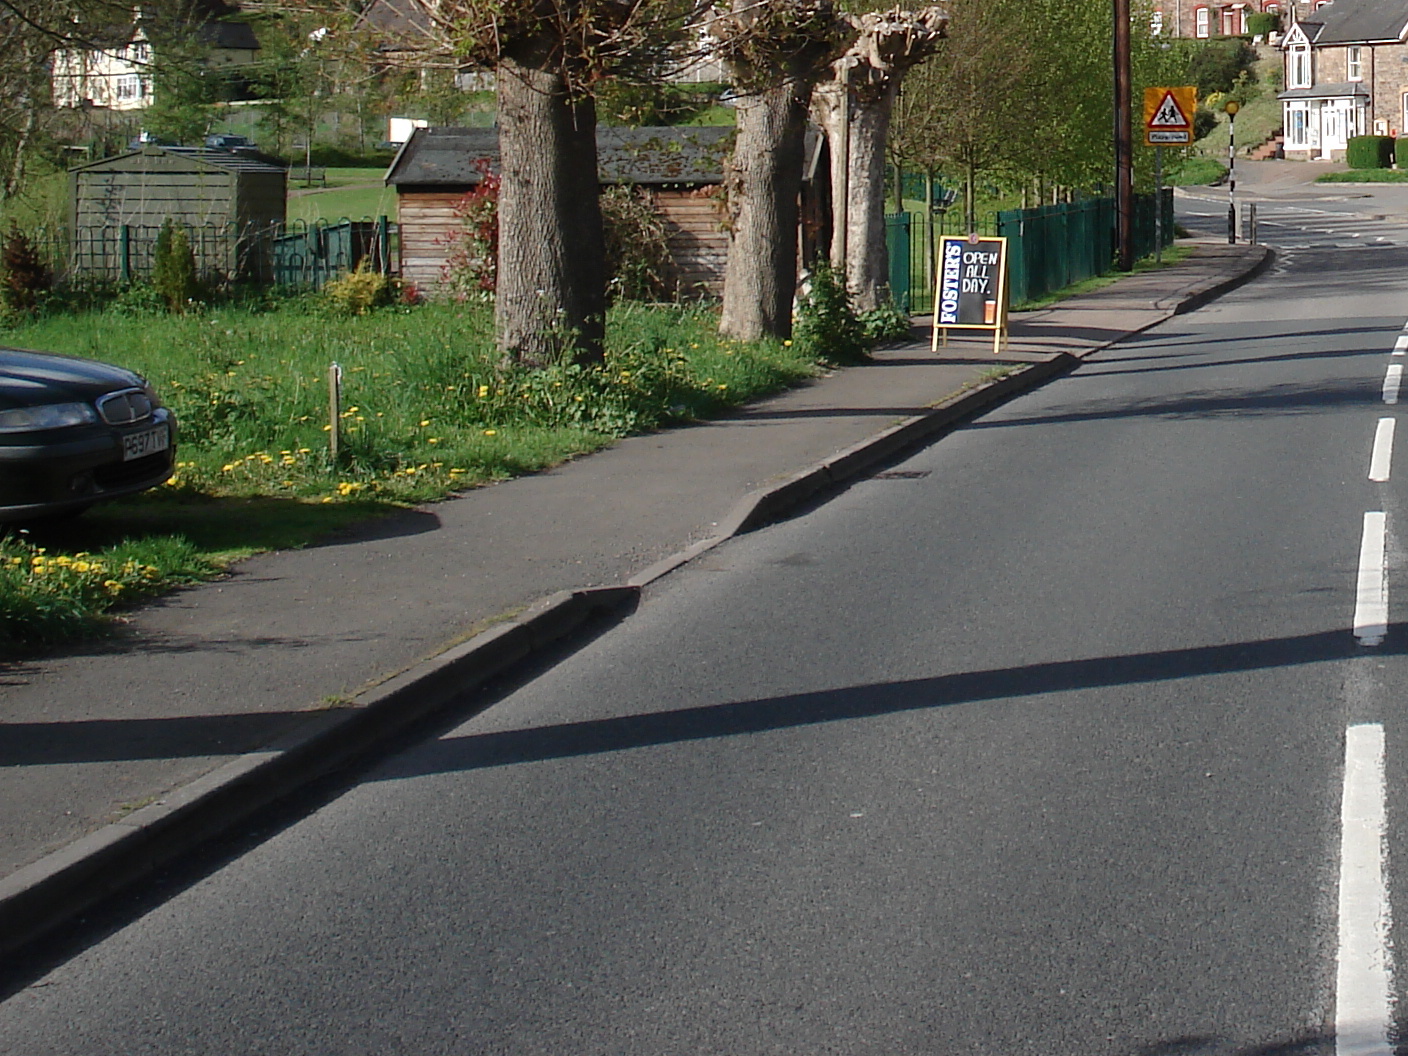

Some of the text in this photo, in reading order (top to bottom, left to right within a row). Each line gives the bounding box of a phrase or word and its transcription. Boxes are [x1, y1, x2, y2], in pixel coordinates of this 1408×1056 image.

[963, 251, 998, 265] OPEN
[965, 265, 989, 279] ALL
[941, 244, 961, 323] FOSTER'S
[962, 278, 991, 294] DAY.
